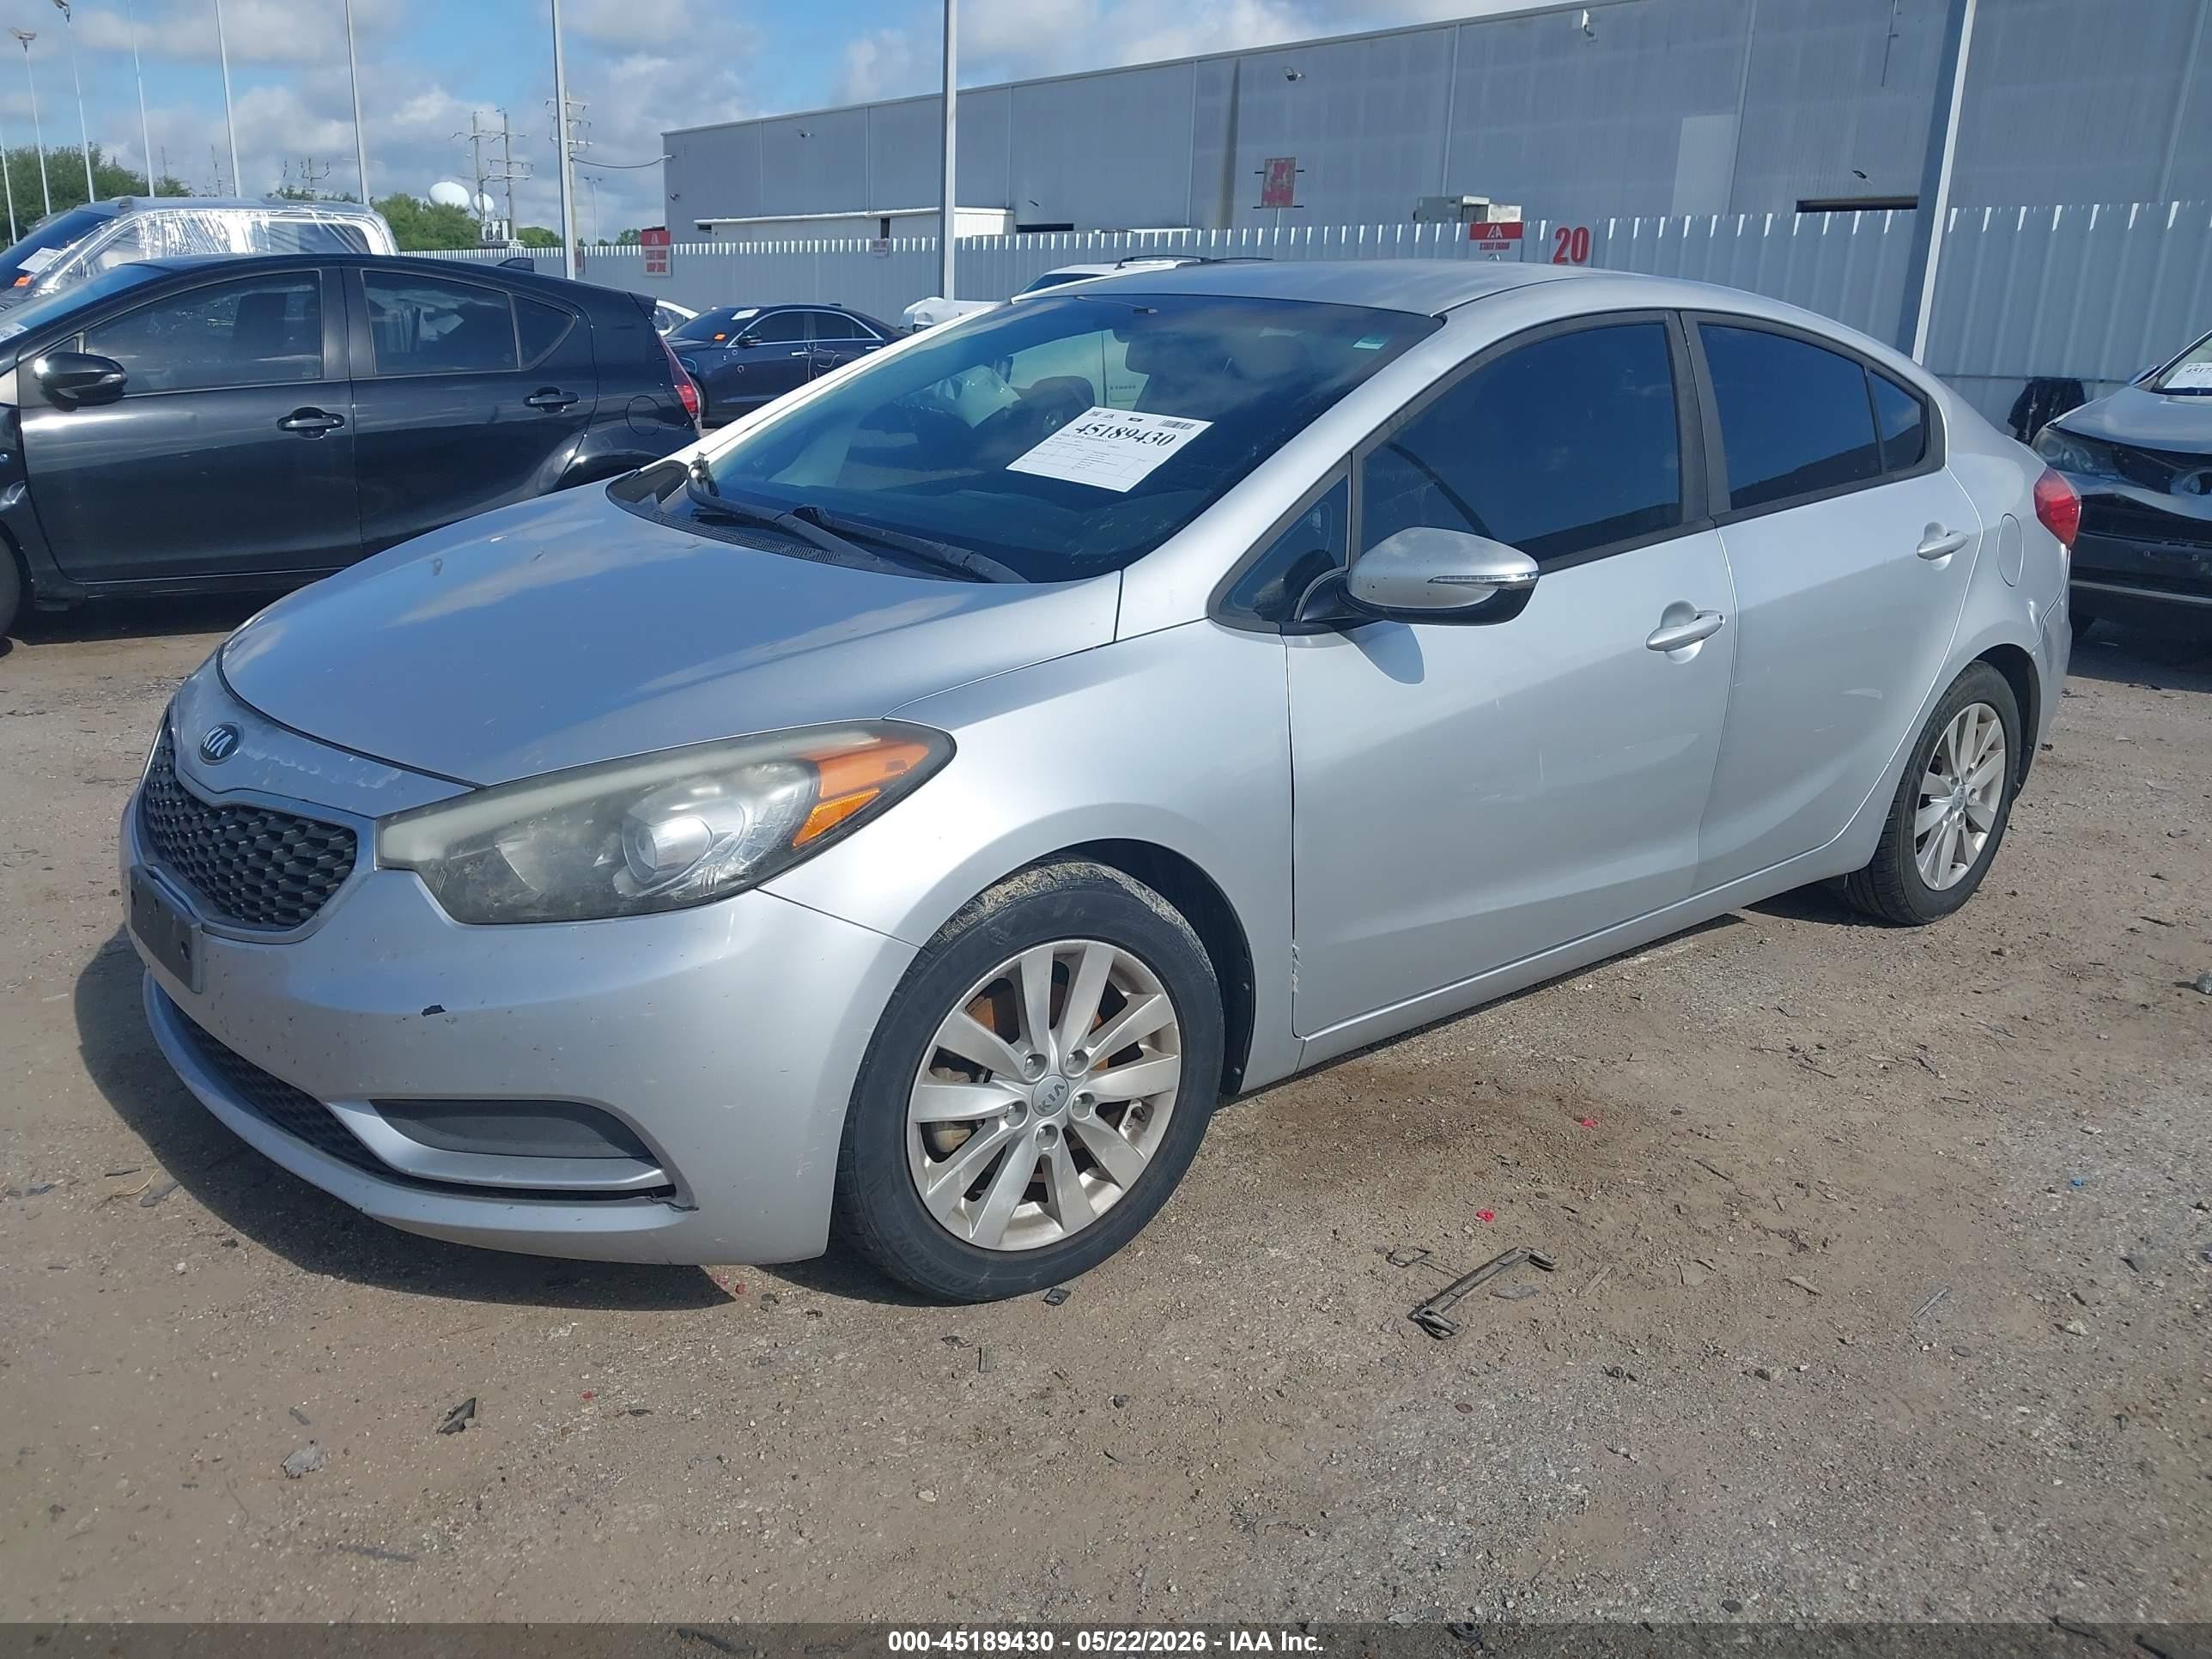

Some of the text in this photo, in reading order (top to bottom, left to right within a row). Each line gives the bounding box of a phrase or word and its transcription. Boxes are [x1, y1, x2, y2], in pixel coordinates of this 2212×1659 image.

[1553, 227, 1589, 263] 20
[1075, 422, 1176, 447] 45189430
[202, 726, 234, 757] KIA
[1037, 1084, 1065, 1113] KIA
